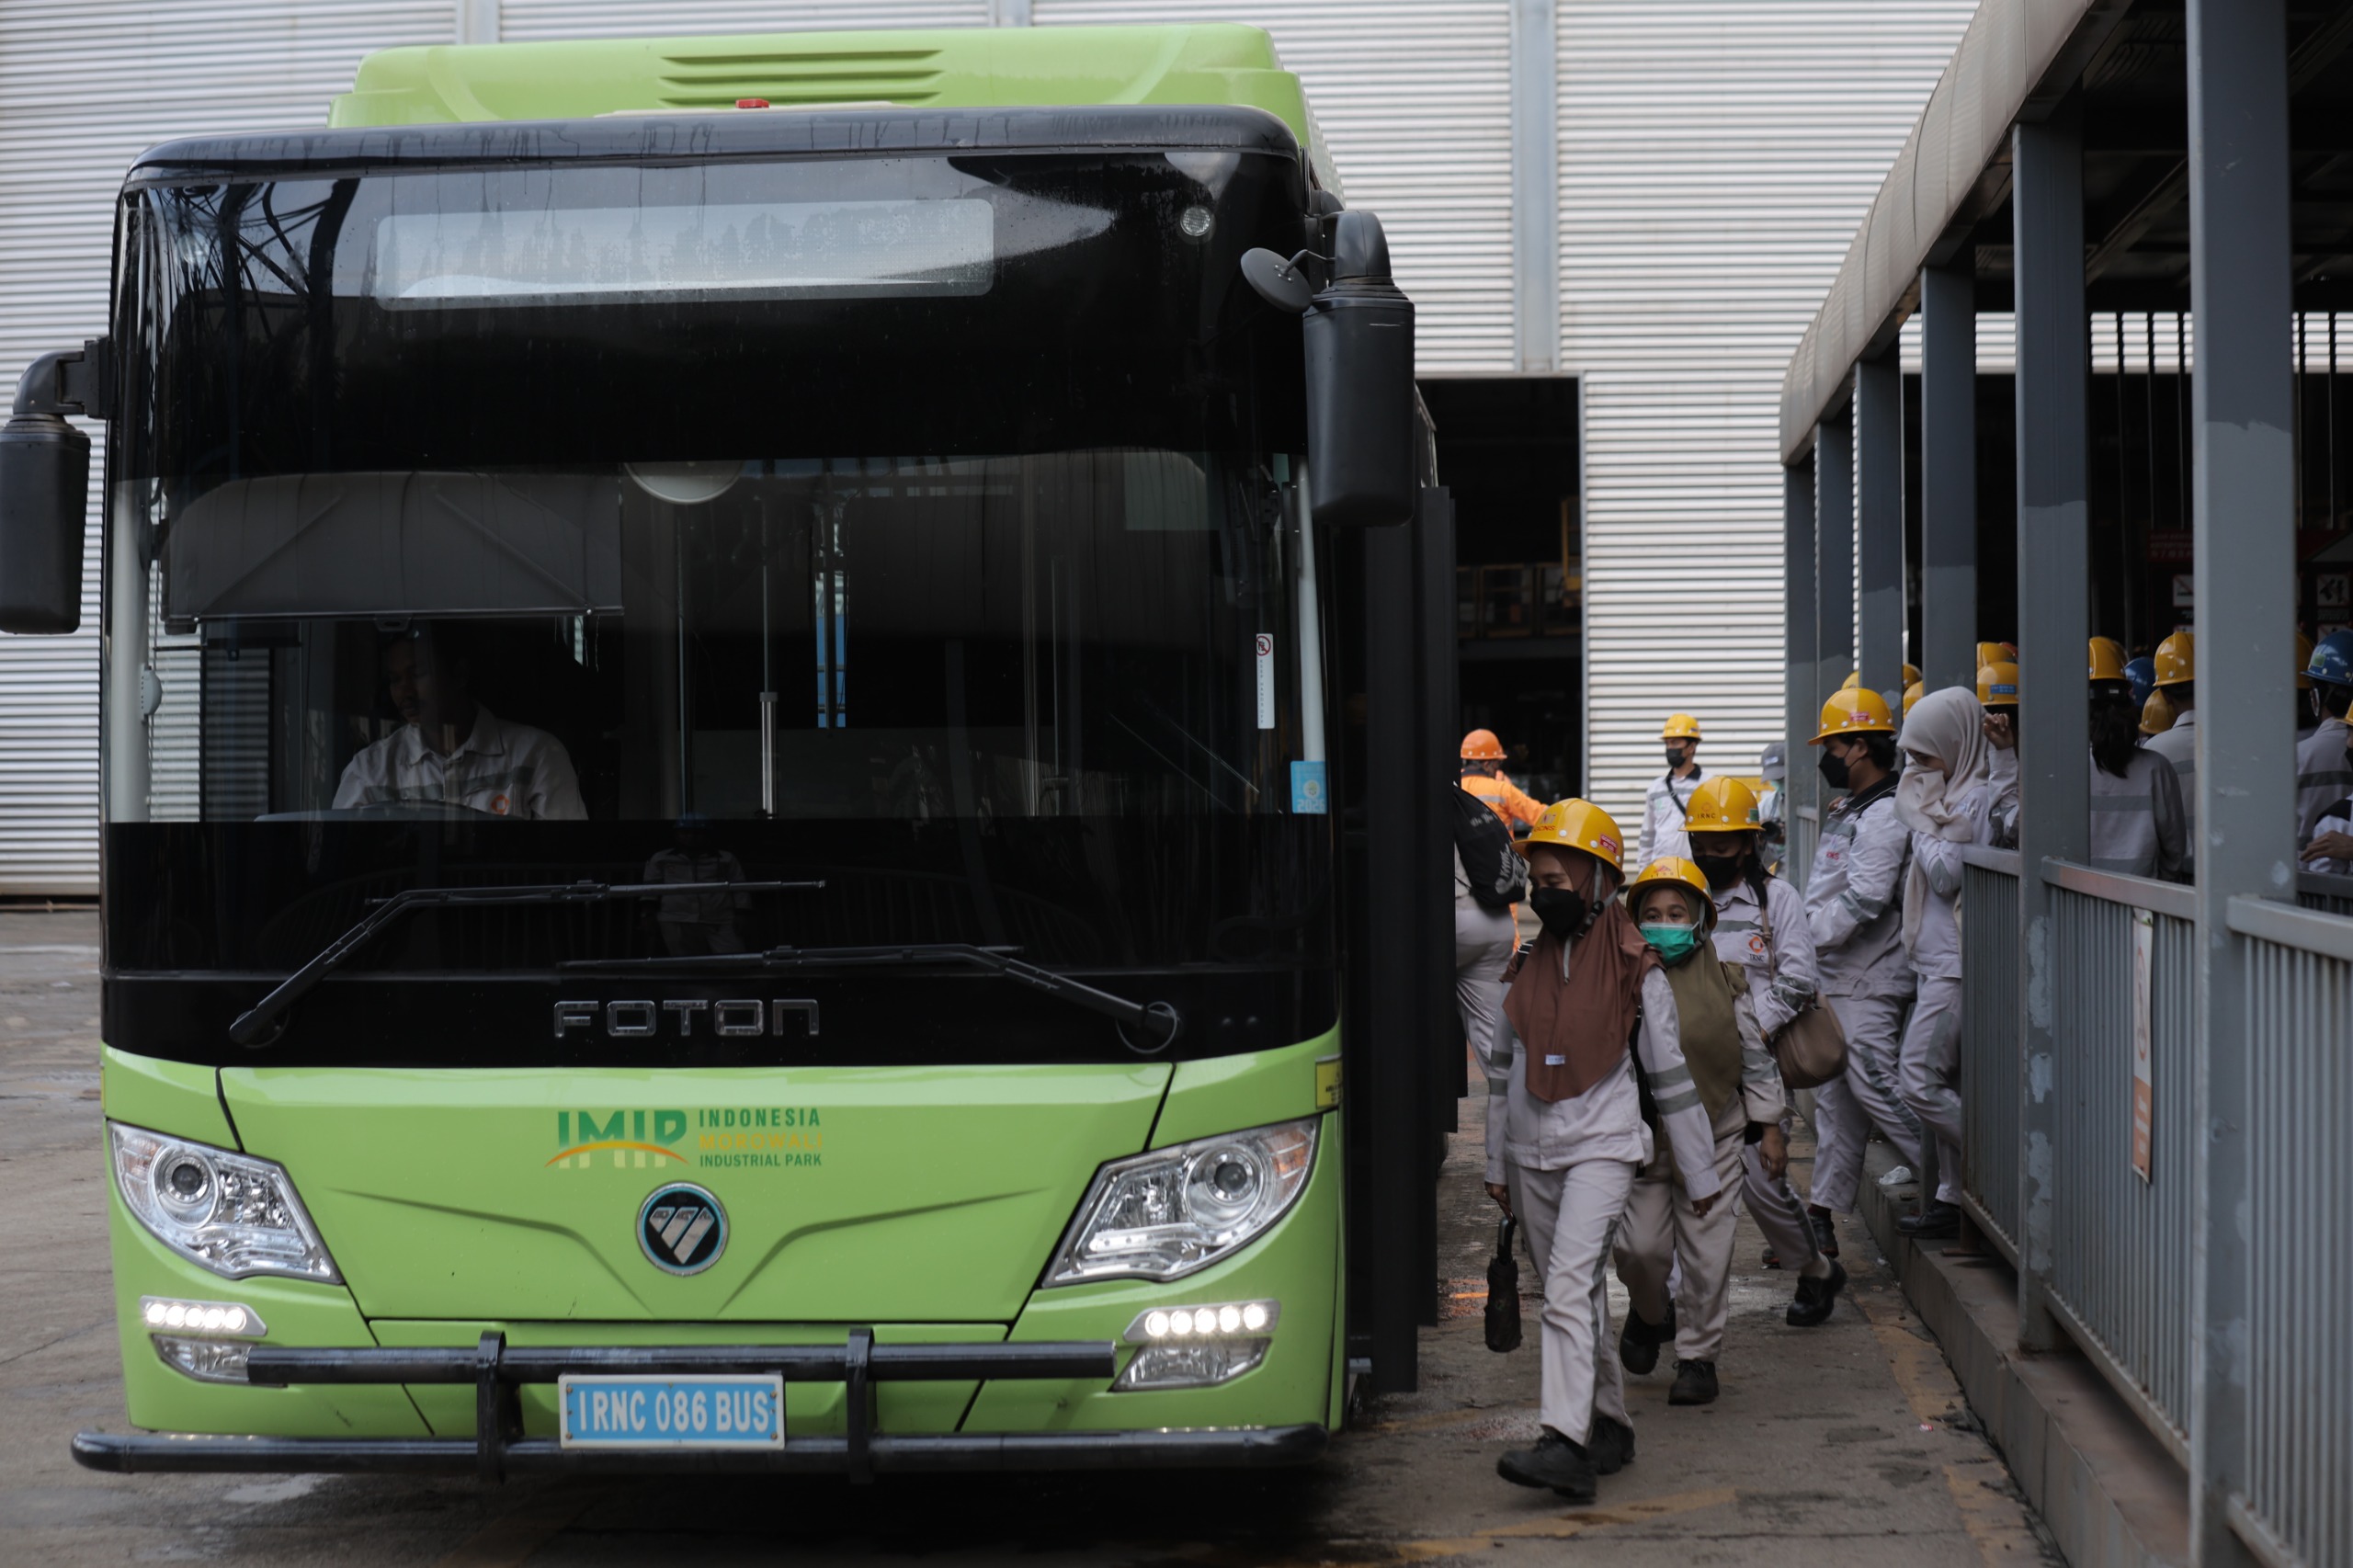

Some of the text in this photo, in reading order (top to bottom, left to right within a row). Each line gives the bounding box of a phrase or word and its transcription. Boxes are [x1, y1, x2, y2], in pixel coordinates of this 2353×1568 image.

[1297, 798, 1325, 812] 2026
[553, 999, 820, 1038] FOTON
[699, 1108, 821, 1128] INDONESIA
[558, 1109, 688, 1168] IMIP
[699, 1132, 824, 1151] MOROWALI
[699, 1153, 823, 1167] INDUSTRIAL PARK
[655, 1391, 708, 1433] 086
[715, 1391, 769, 1433] BUS
